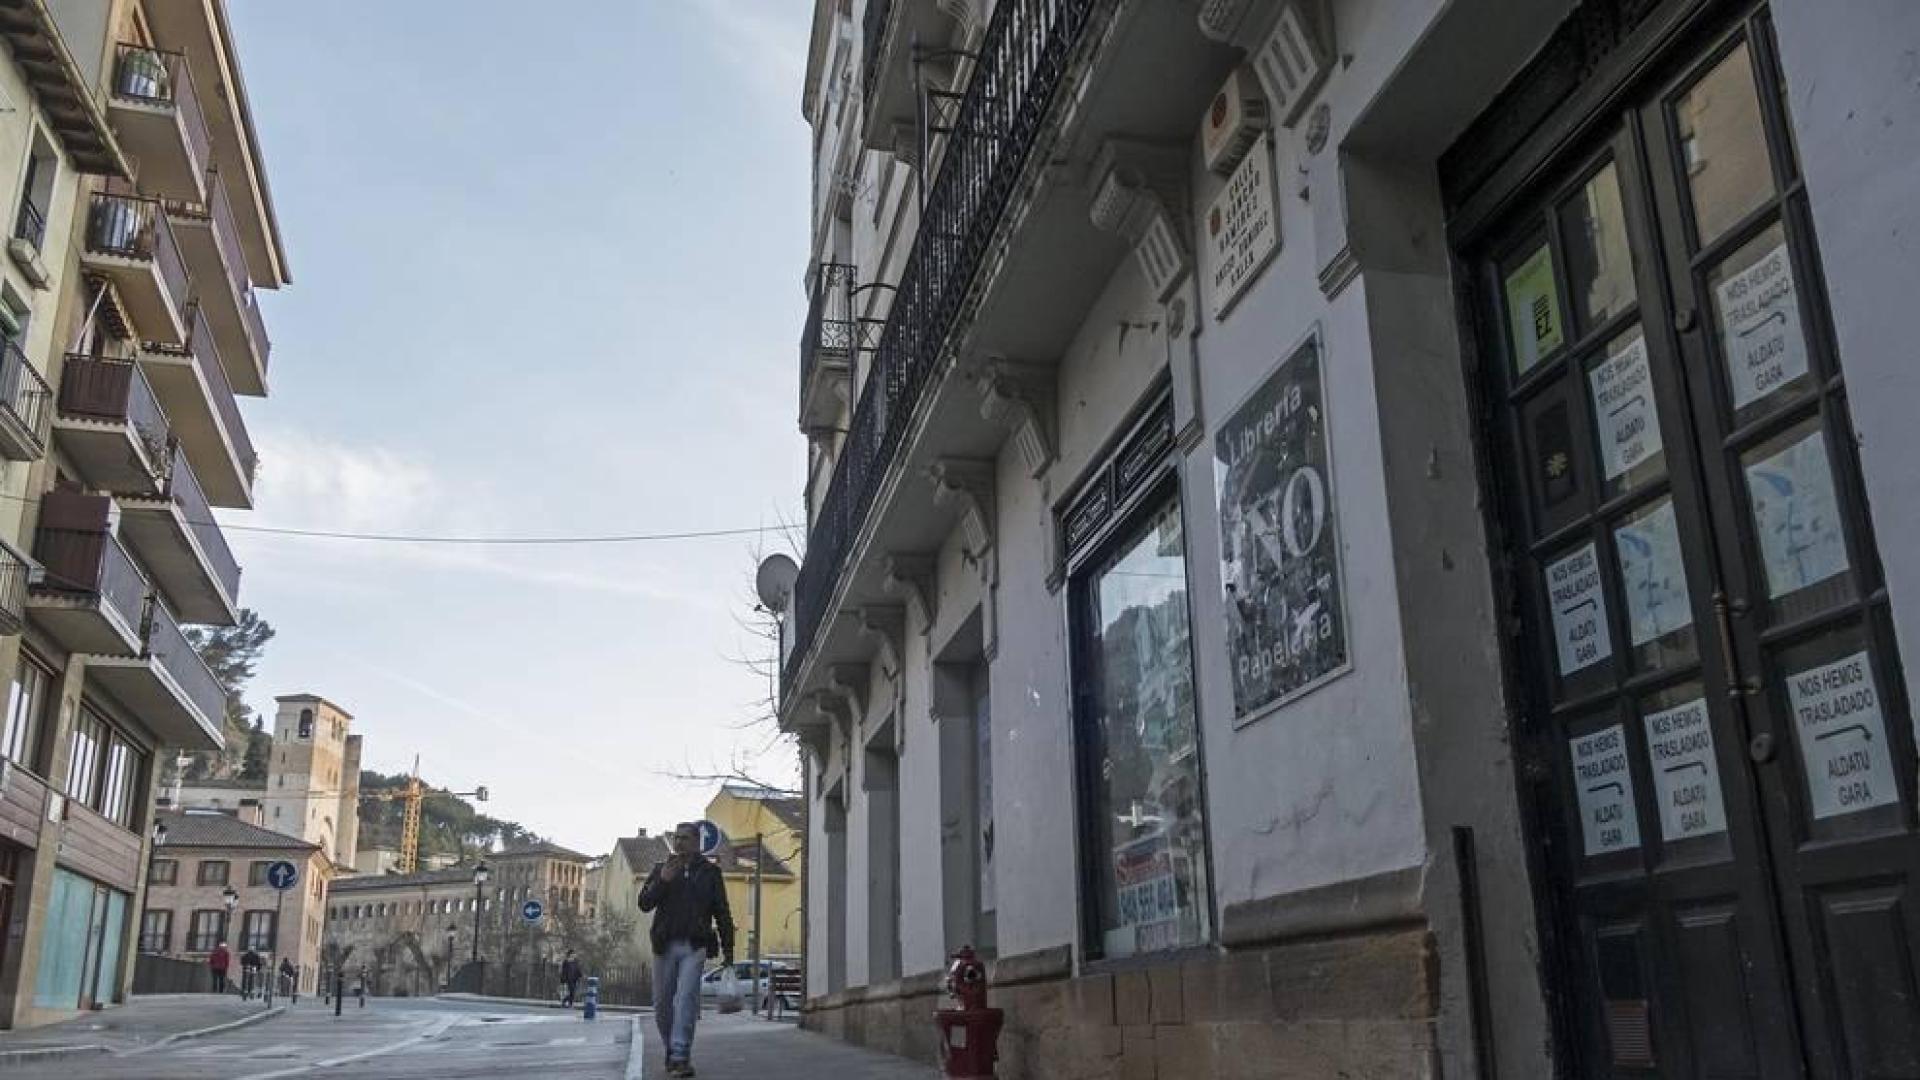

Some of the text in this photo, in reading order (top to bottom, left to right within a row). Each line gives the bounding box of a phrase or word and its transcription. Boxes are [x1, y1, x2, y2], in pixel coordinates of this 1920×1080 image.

[1797, 661, 1863, 698] NOS HEMOS
[1652, 706, 1702, 735] NOS HEMOS
[1799, 687, 1874, 727] TRASLADADO
[1576, 730, 1620, 758] NOS HEMOS
[1653, 730, 1710, 760] TRASLADADO
[1828, 750, 1871, 779] ALDATU
[1672, 785, 1707, 808] ALDATU
[1838, 779, 1873, 806] GARA
[1681, 811, 1707, 832] GARA
[1601, 827, 1623, 847] GARA
